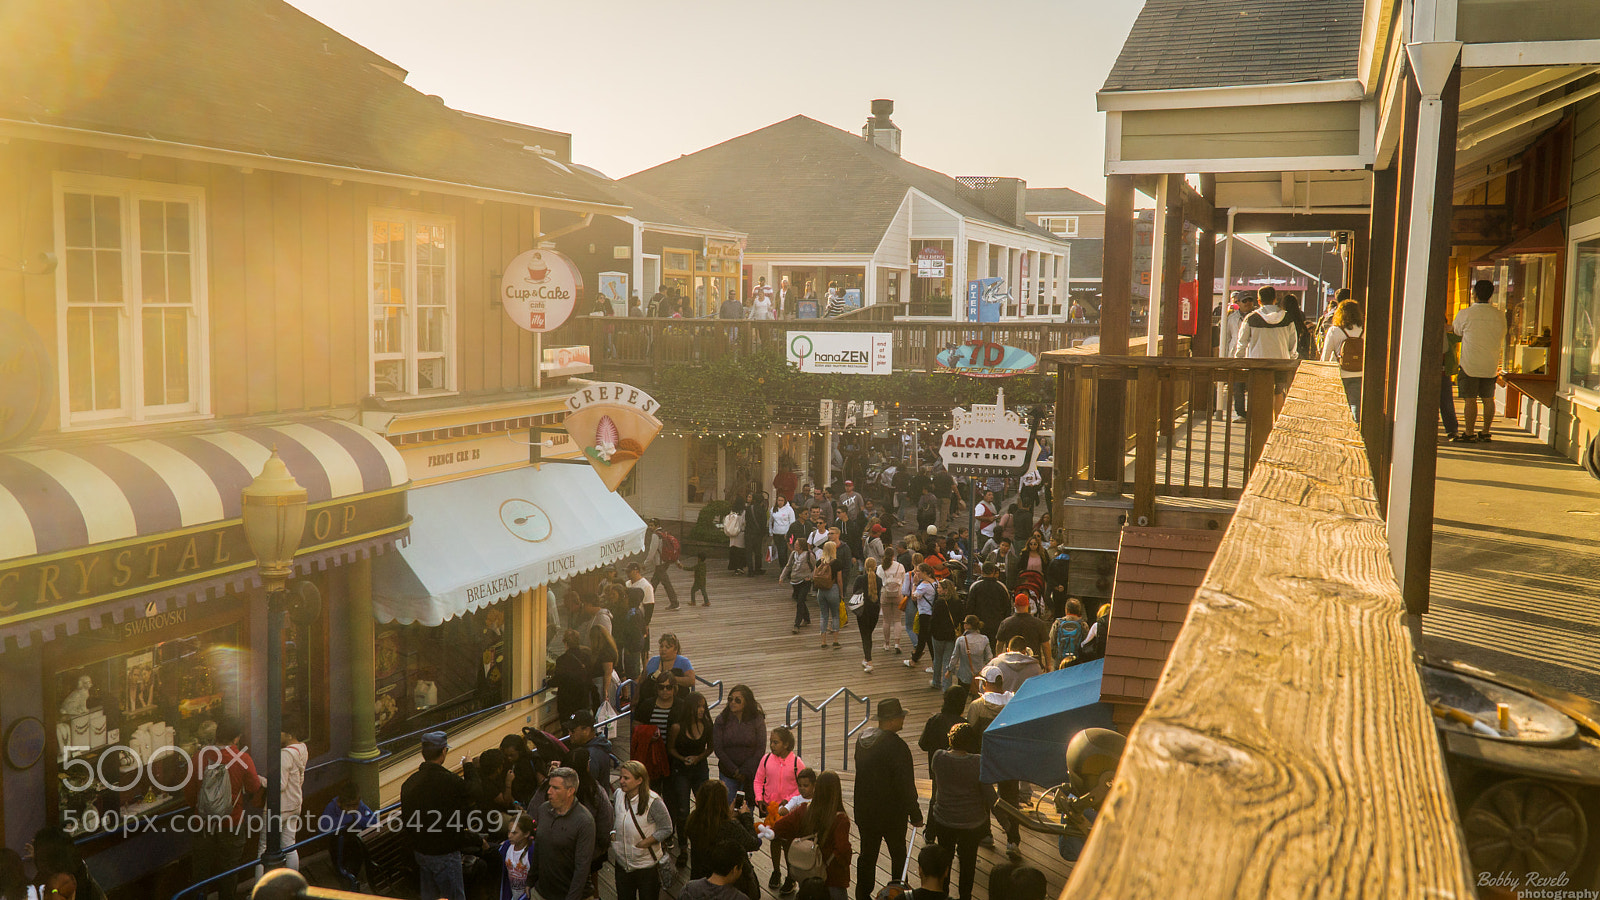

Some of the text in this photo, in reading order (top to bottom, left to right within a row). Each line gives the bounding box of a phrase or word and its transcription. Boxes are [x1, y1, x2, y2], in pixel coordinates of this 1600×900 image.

[531, 314, 545, 327] illy
[814, 350, 869, 363] hanaZEN
[965, 339, 1005, 367] 7D
[569, 386, 655, 413] CREPES
[944, 434, 1028, 451] ALCATRAZ
[428, 448, 480, 468] FRENCH CREES
[951, 451, 1016, 461] GIFT SHOP
[956, 466, 1010, 476] UPSTAIRS
[0, 504, 357, 612] CRYSTAL OP
[466, 539, 626, 603] BREAKFAST LUNCH DINNER
[124, 608, 187, 638] SWAROVSKI
